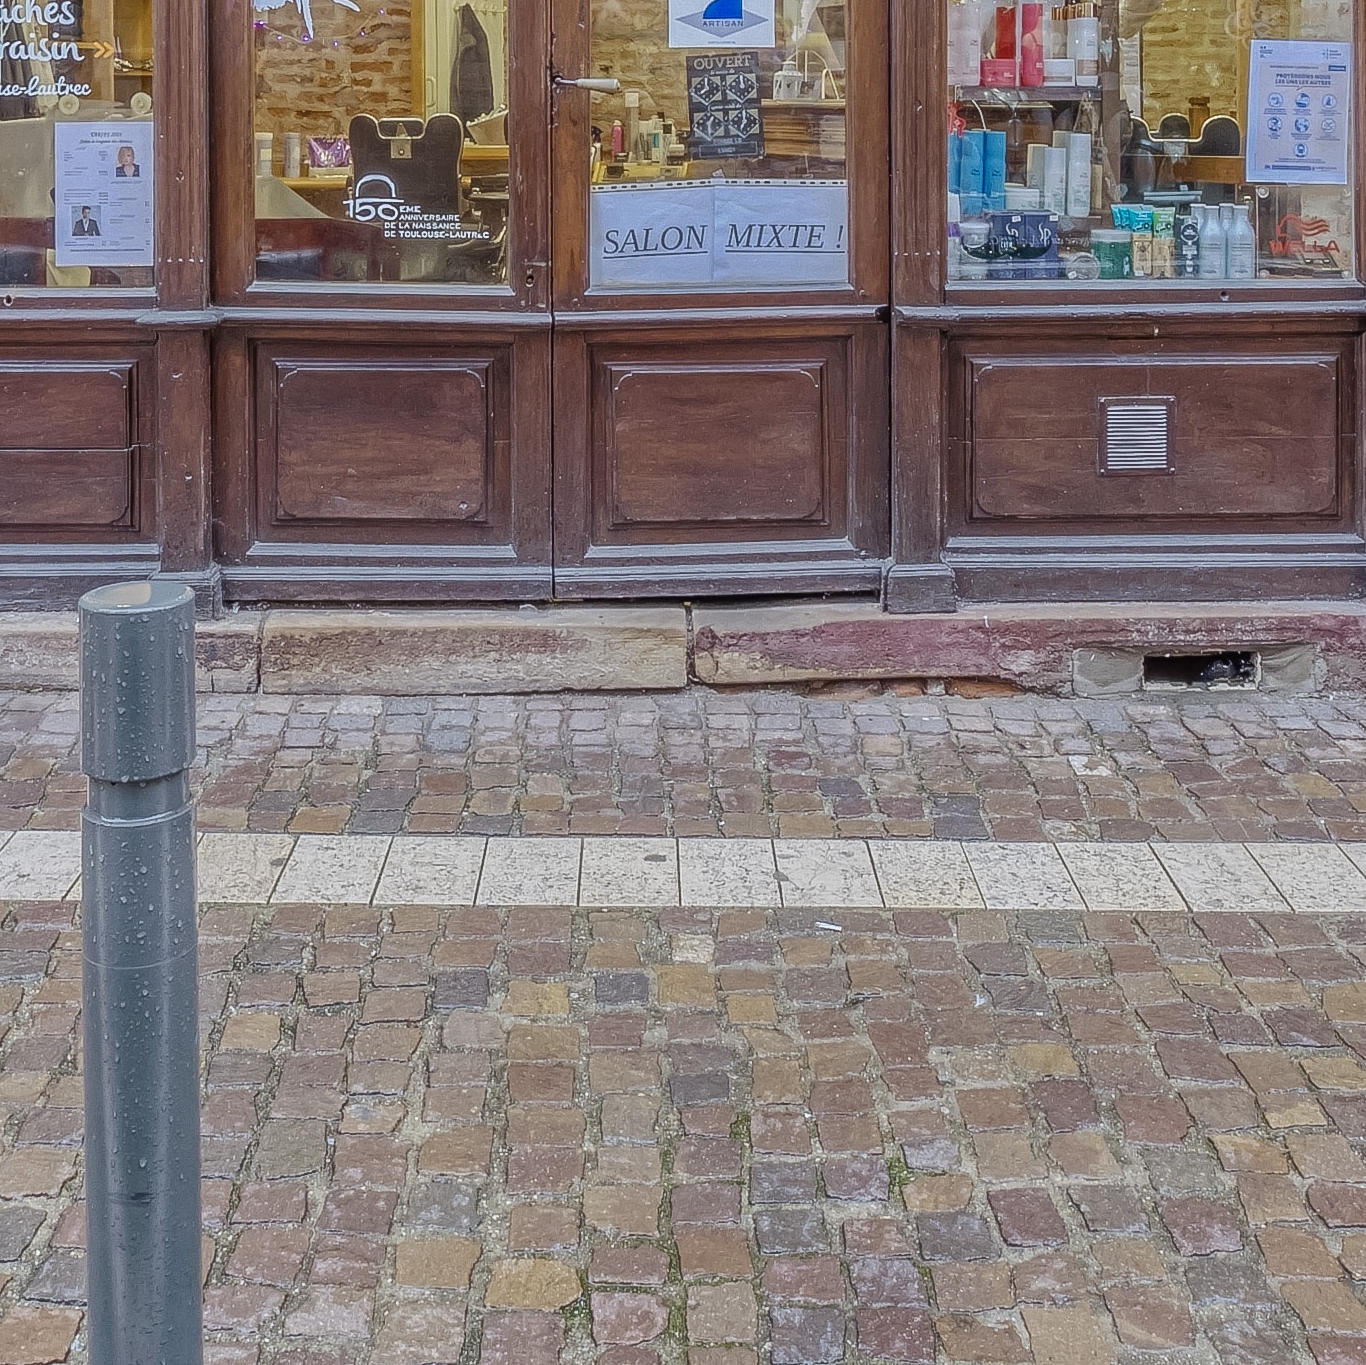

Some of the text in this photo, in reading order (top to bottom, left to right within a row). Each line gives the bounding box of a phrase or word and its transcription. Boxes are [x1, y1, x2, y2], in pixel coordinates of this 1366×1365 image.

[702, 19, 744, 28] ARTISAN
[694, 54, 751, 70] OUVERT
[343, 197, 400, 221] 150
[398, 214, 460, 222] ANNIVERSAIRE
[384, 222, 461, 230] DE LA NAISSANCE
[384, 230, 490, 239] DE TOULOUSE-LAUTREC
[603, 224, 708, 254] SALON
[726, 223, 826, 249] MIXTE
[1268, 239, 1341, 255] WELLA
